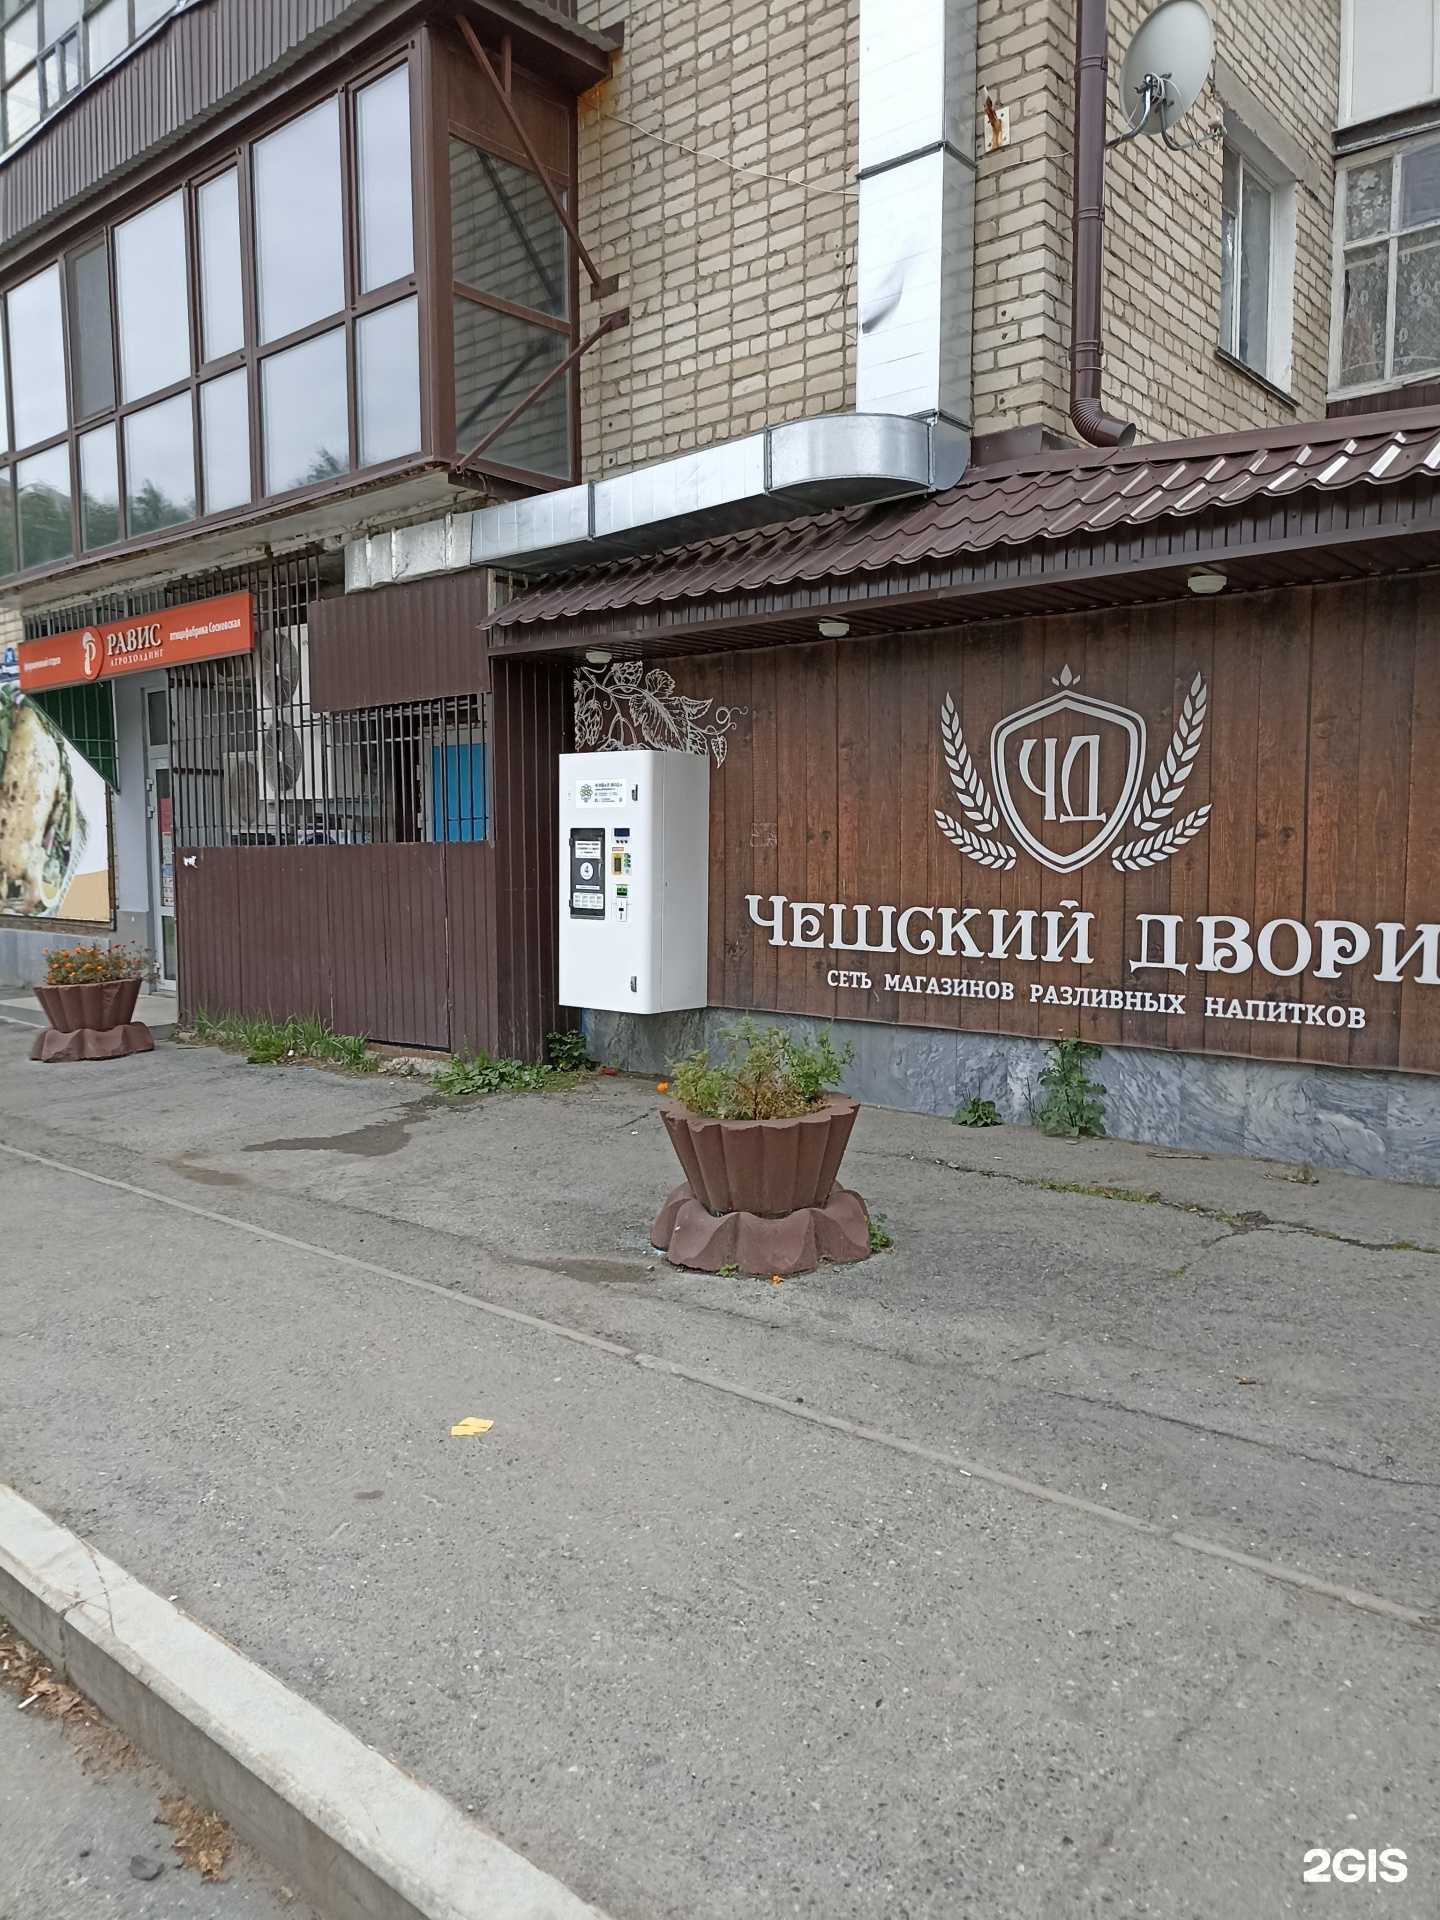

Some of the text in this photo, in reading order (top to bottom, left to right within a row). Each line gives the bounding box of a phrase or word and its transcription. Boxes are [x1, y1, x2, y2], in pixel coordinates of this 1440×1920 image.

[106, 623, 162, 656] РАВИС
[1019, 734, 1107, 824] ЧД
[744, 894, 1440, 986] ЧЕШСКИЙ ДВОРИ
[826, 969, 1367, 1030] СЕТЬ МАГАЗИНОВ РАЗЛИВНЫХ НАПИТКОВ
